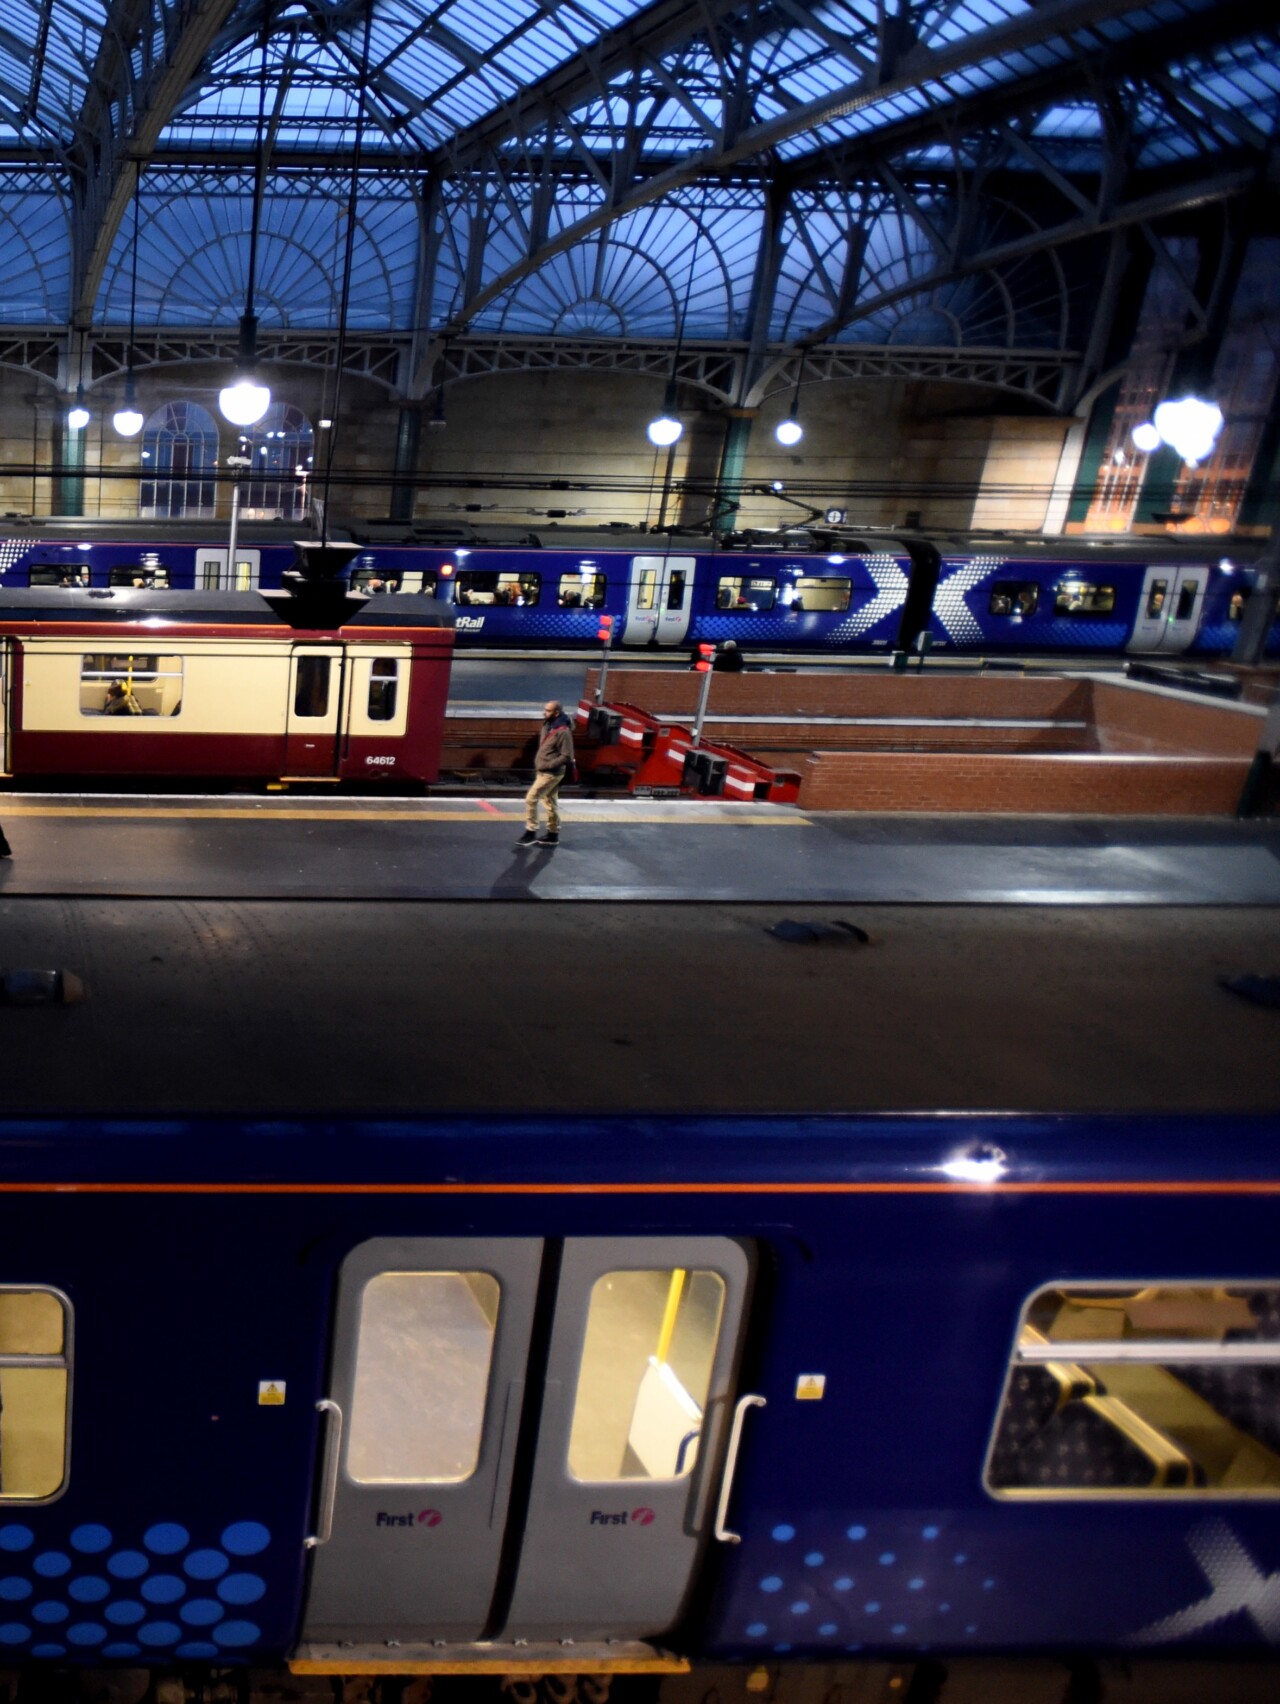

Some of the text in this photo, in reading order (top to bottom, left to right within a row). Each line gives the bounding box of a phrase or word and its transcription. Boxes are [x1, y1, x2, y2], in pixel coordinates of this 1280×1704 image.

[366, 755, 396, 766] 64612
[376, 1512, 415, 1527] First
[590, 1511, 628, 1525] First
